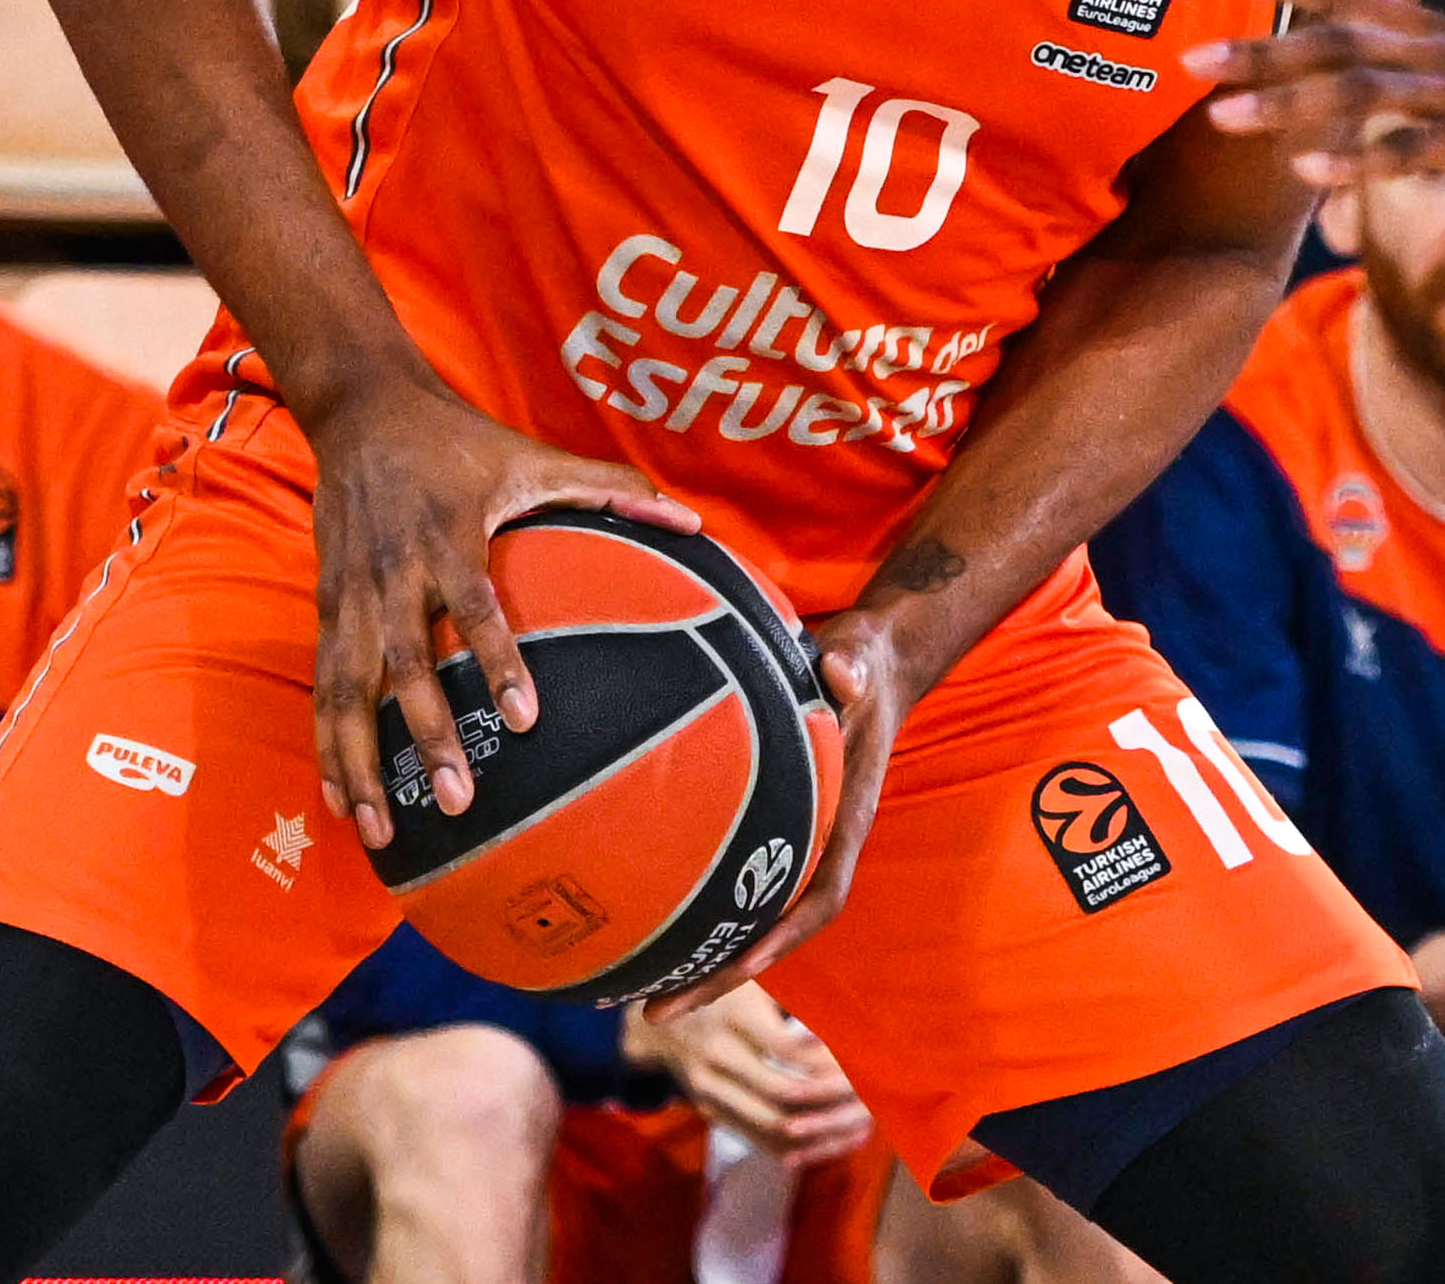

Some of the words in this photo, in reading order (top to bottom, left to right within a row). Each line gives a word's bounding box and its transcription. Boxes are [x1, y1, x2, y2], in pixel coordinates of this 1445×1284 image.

[1076, 5, 1152, 33] EuroLeague
[1032, 42, 1156, 91] oneteam
[777, 77, 981, 252] 10
[96, 741, 183, 783] PULEVA
[250, 847, 295, 893] luanvi
[1072, 834, 1148, 880] TURKISH
[1081, 847, 1156, 894] AIRLINES
[1086, 862, 1162, 906] EuroLeague
